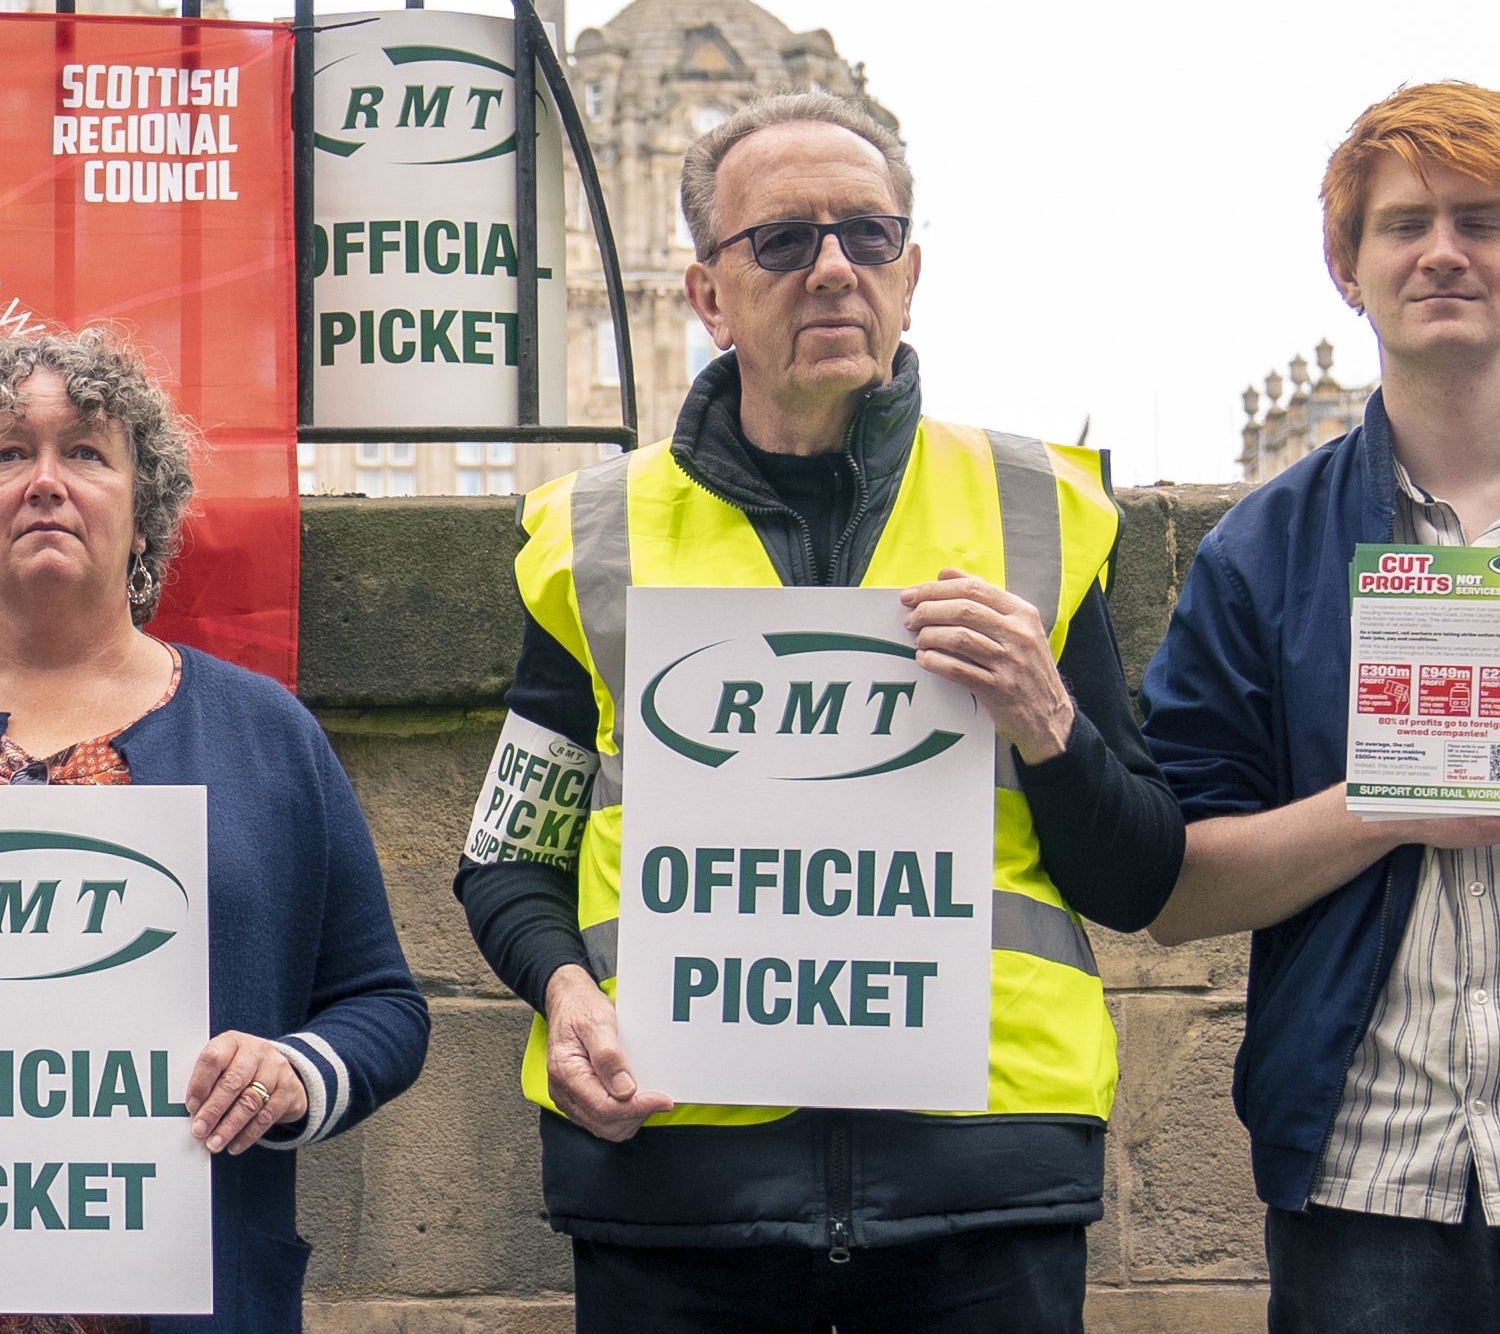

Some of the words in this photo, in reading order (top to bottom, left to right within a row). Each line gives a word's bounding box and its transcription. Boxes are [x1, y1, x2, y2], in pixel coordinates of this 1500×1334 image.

[62, 63, 239, 109] SCOTTISH
[340, 83, 504, 132] RMT
[53, 112, 239, 156] REGIONAL
[84, 159, 239, 204] COUNCIL
[312, 218, 554, 282] FFICIA
[319, 308, 520, 368] PICKET
[1361, 575, 1450, 592] PROFITS
[1456, 575, 1483, 586] NOT
[1382, 556, 1431, 573] CUT
[1455, 586, 1500, 596] SERVICES
[1360, 665, 1410, 678] £300m
[1421, 666, 1471, 679] £949m
[709, 680, 918, 737] RMT
[1378, 717, 1397, 726] 80%
[1399, 718, 1409, 726] of
[1410, 718, 1443, 729] profits
[1444, 720, 1457, 730] go
[1458, 720, 1468, 728] to
[556, 746, 586, 762] RMT
[1397, 728, 1429, 736] owned
[1431, 729, 1489, 739] companies!
[1359, 785, 1411, 797] SUPPORT
[1414, 787, 1439, 798] OUR
[1440, 788, 1466, 799] RAIL
[641, 844, 975, 920] OFFICIAL
[672, 955, 939, 1030] PICKET
